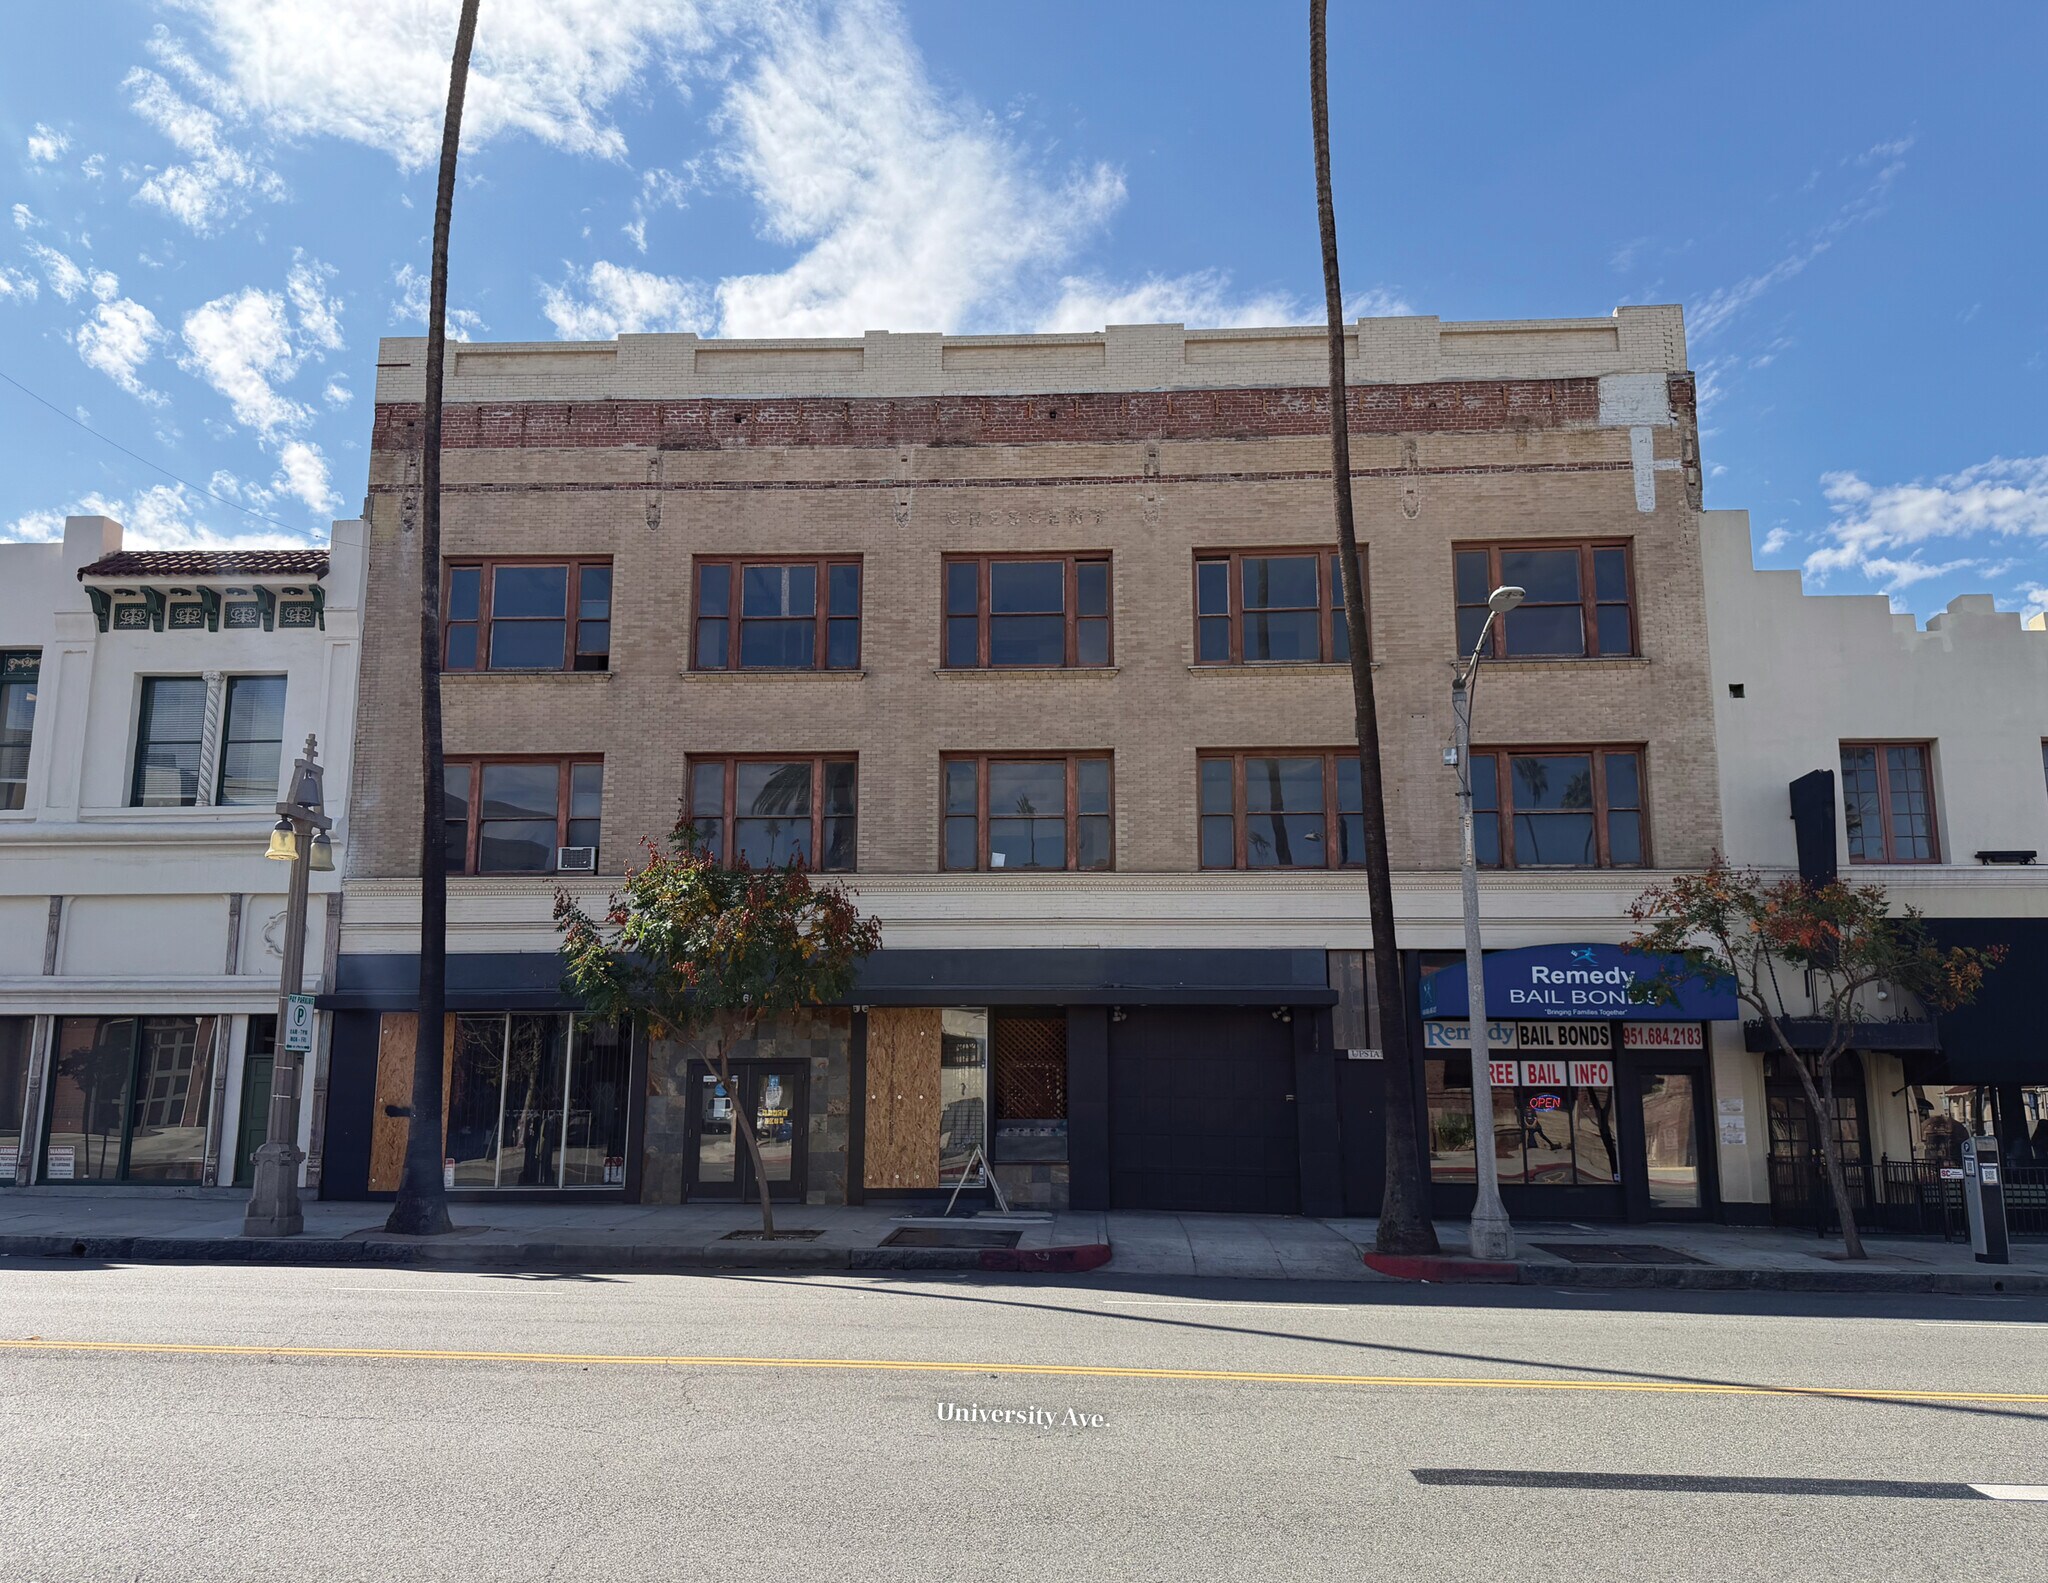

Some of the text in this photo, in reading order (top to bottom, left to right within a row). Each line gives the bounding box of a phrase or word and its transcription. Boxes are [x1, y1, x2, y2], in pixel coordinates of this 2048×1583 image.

[947, 508, 1110, 527] CRESCENT
[1531, 966, 1636, 989] Remedy
[297, 996, 314, 1005] PARKING
[1509, 989, 1565, 1004] BAIL
[1426, 1022, 1514, 1046] Remdy
[1520, 1025, 1609, 1046] BAIL BONDS
[1623, 1027, 1701, 1046] 951.684.2183
[1489, 1063, 1514, 1085] REE
[1527, 1063, 1561, 1084] BAIL
[1574, 1063, 1609, 1085] INFO
[1529, 1097, 1561, 1108] OPEN
